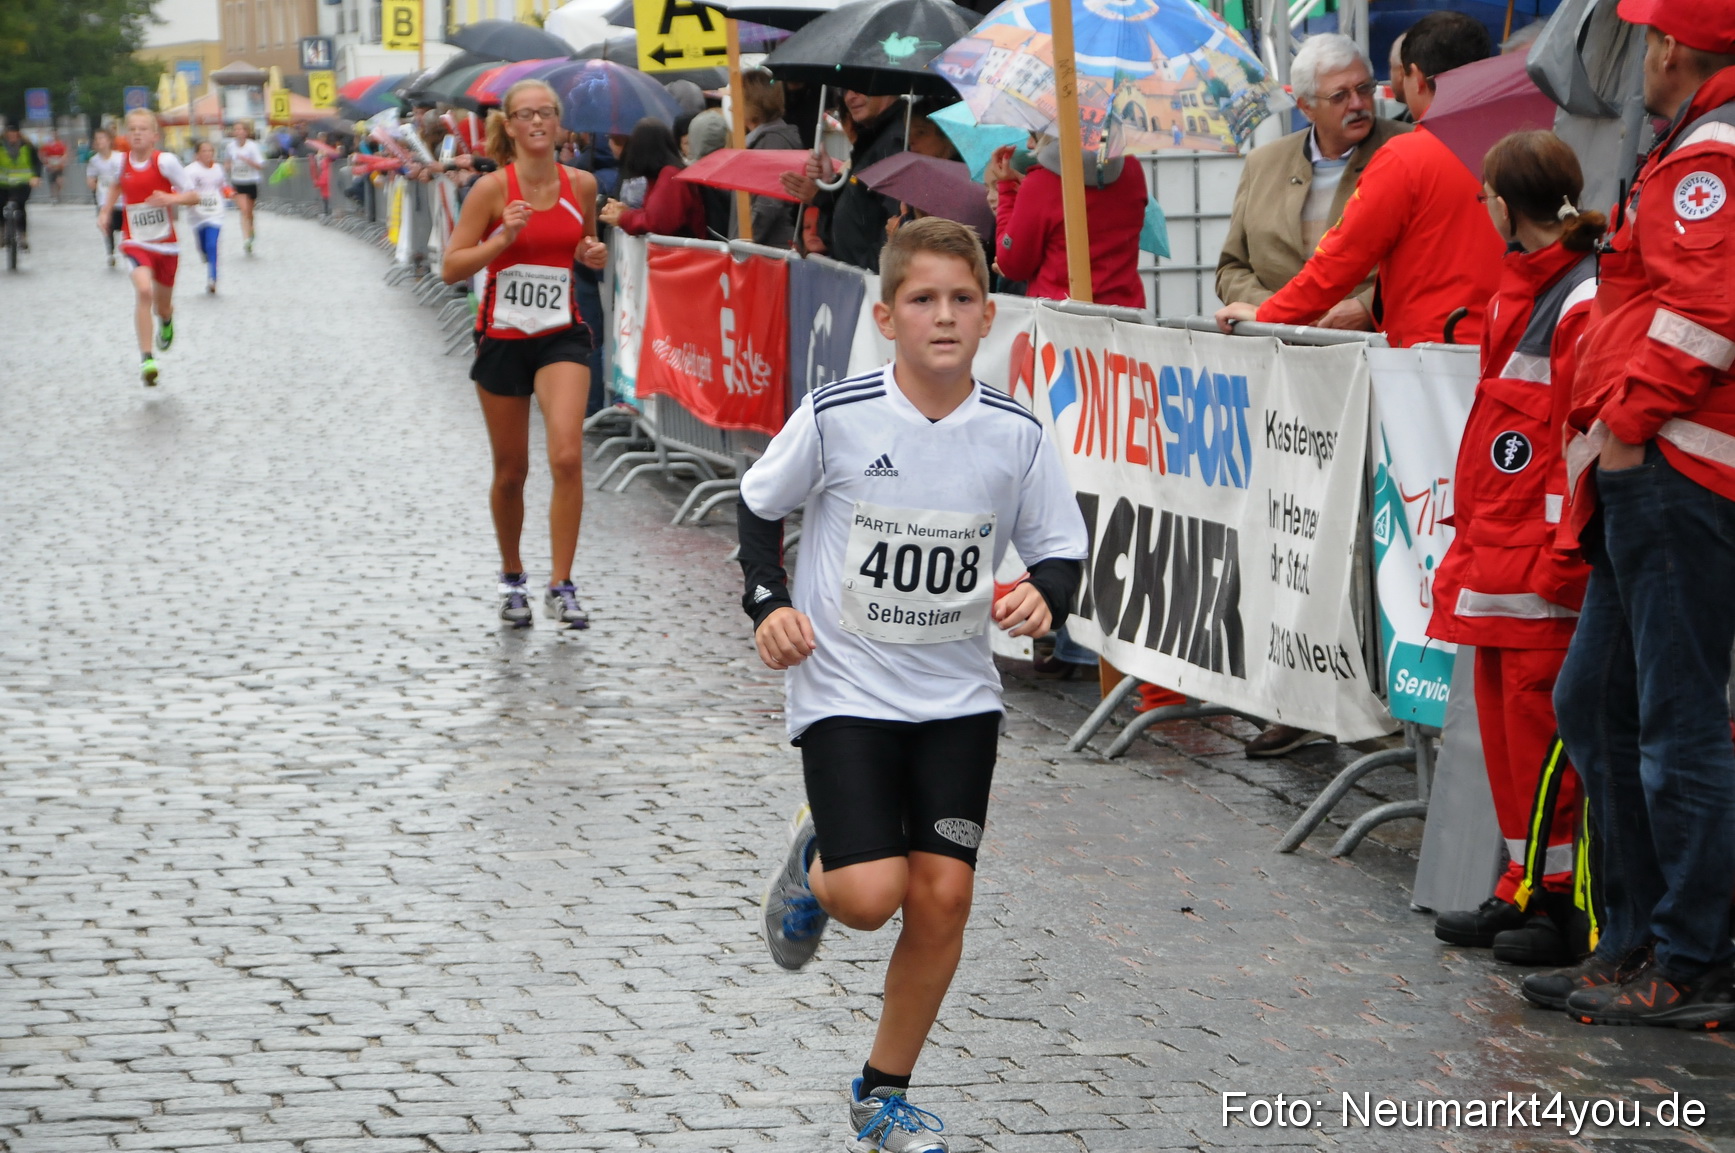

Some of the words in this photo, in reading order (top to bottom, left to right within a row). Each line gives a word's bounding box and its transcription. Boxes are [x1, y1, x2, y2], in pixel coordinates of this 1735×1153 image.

[393, 6, 414, 37] B
[316, 82, 329, 100] C
[274, 98, 285, 112] D
[1679, 176, 1718, 196] DEUTSCHES
[1679, 199, 1698, 215] ROTES
[1699, 194, 1721, 214] KREUZ
[131, 208, 165, 227] 4050
[525, 271, 558, 281] Neumarkt
[504, 280, 562, 310] 4062
[1073, 346, 1252, 490] INTERSPORT
[864, 468, 899, 477] adidas
[854, 514, 903, 535] PARTL
[907, 523, 976, 540] Neumarkt
[859, 541, 981, 595] 4008
[867, 602, 962, 627] Sebastian
